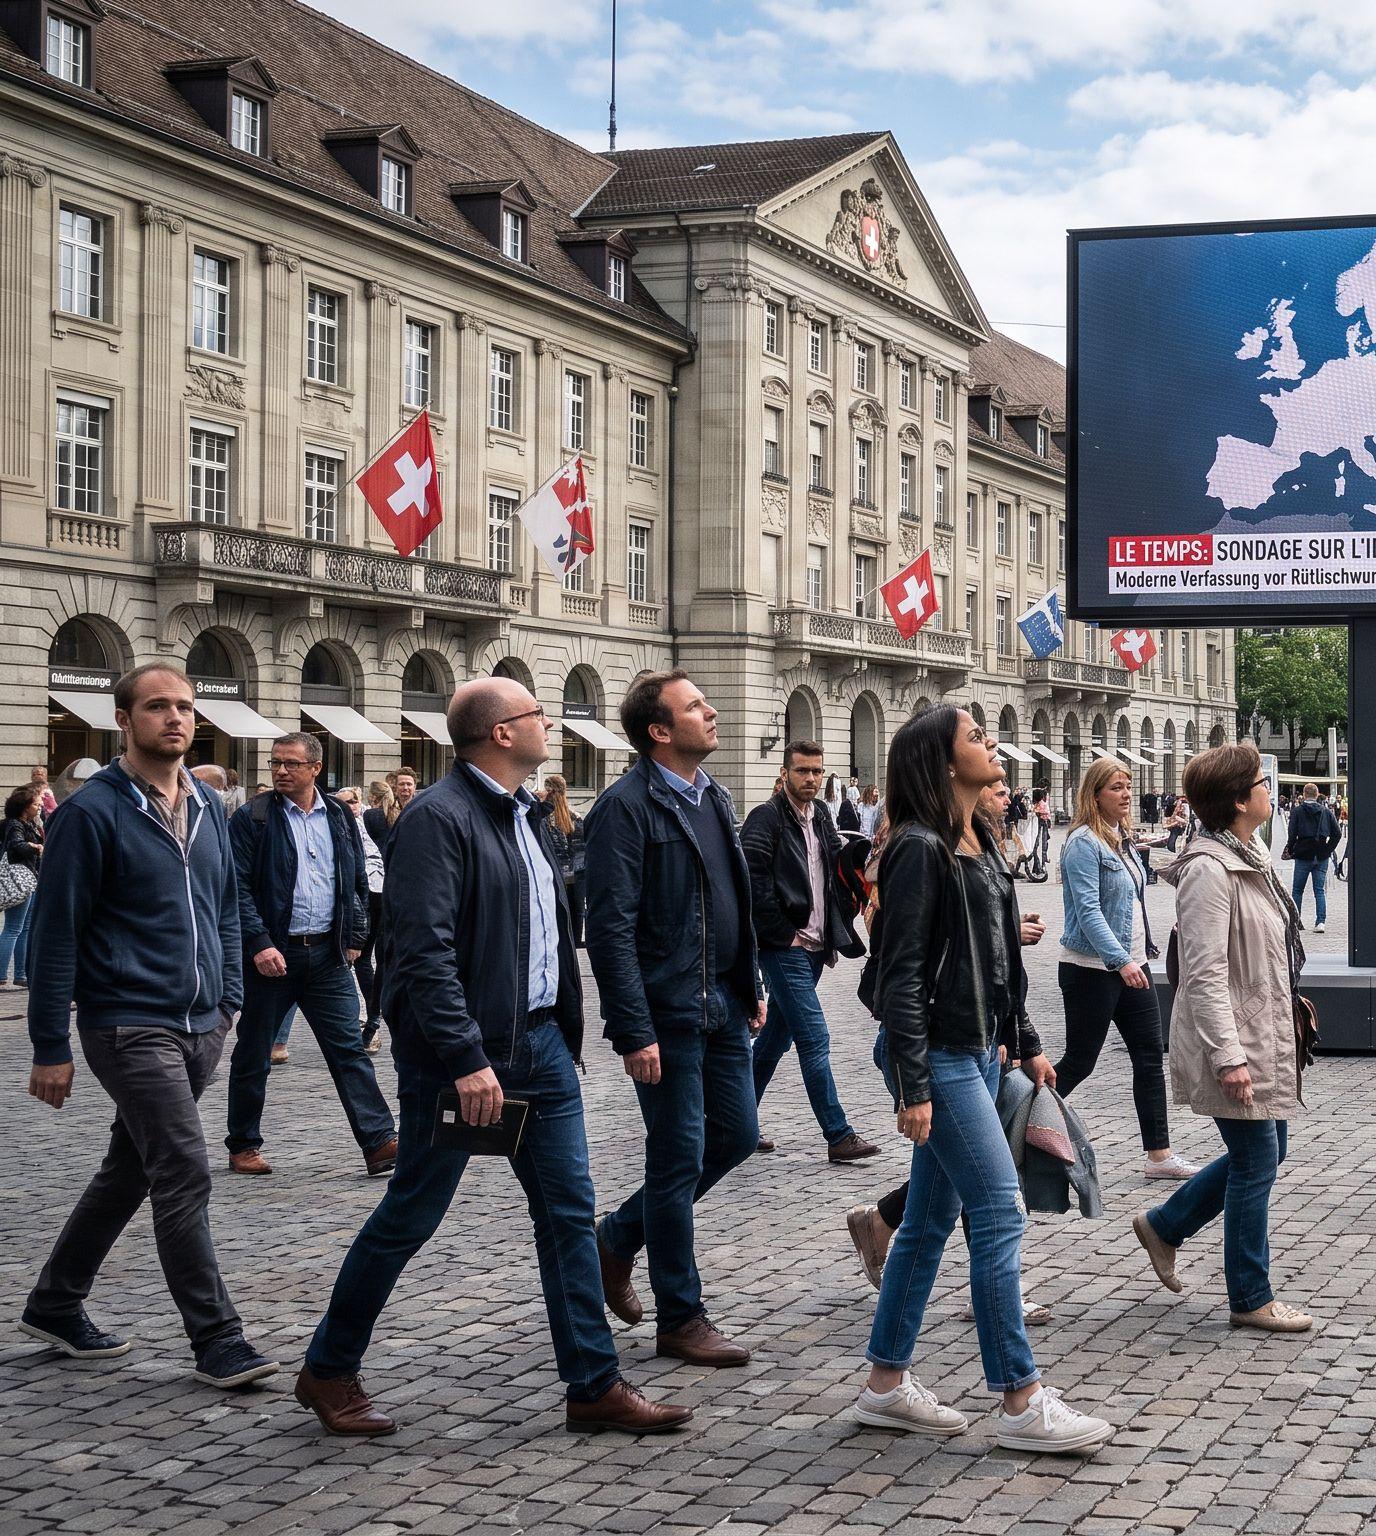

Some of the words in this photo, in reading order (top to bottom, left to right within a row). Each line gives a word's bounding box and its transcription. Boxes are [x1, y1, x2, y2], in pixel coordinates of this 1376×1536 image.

[1115, 541, 1136, 563] LE
[1141, 540, 1208, 562] TEMPS:
[1217, 539, 1303, 561] SONDAGE
[1308, 538, 1345, 559] SUR
[1116, 571, 1176, 588] Moderne
[1181, 570, 1260, 590] Verfassung
[1264, 572, 1287, 586] vor
